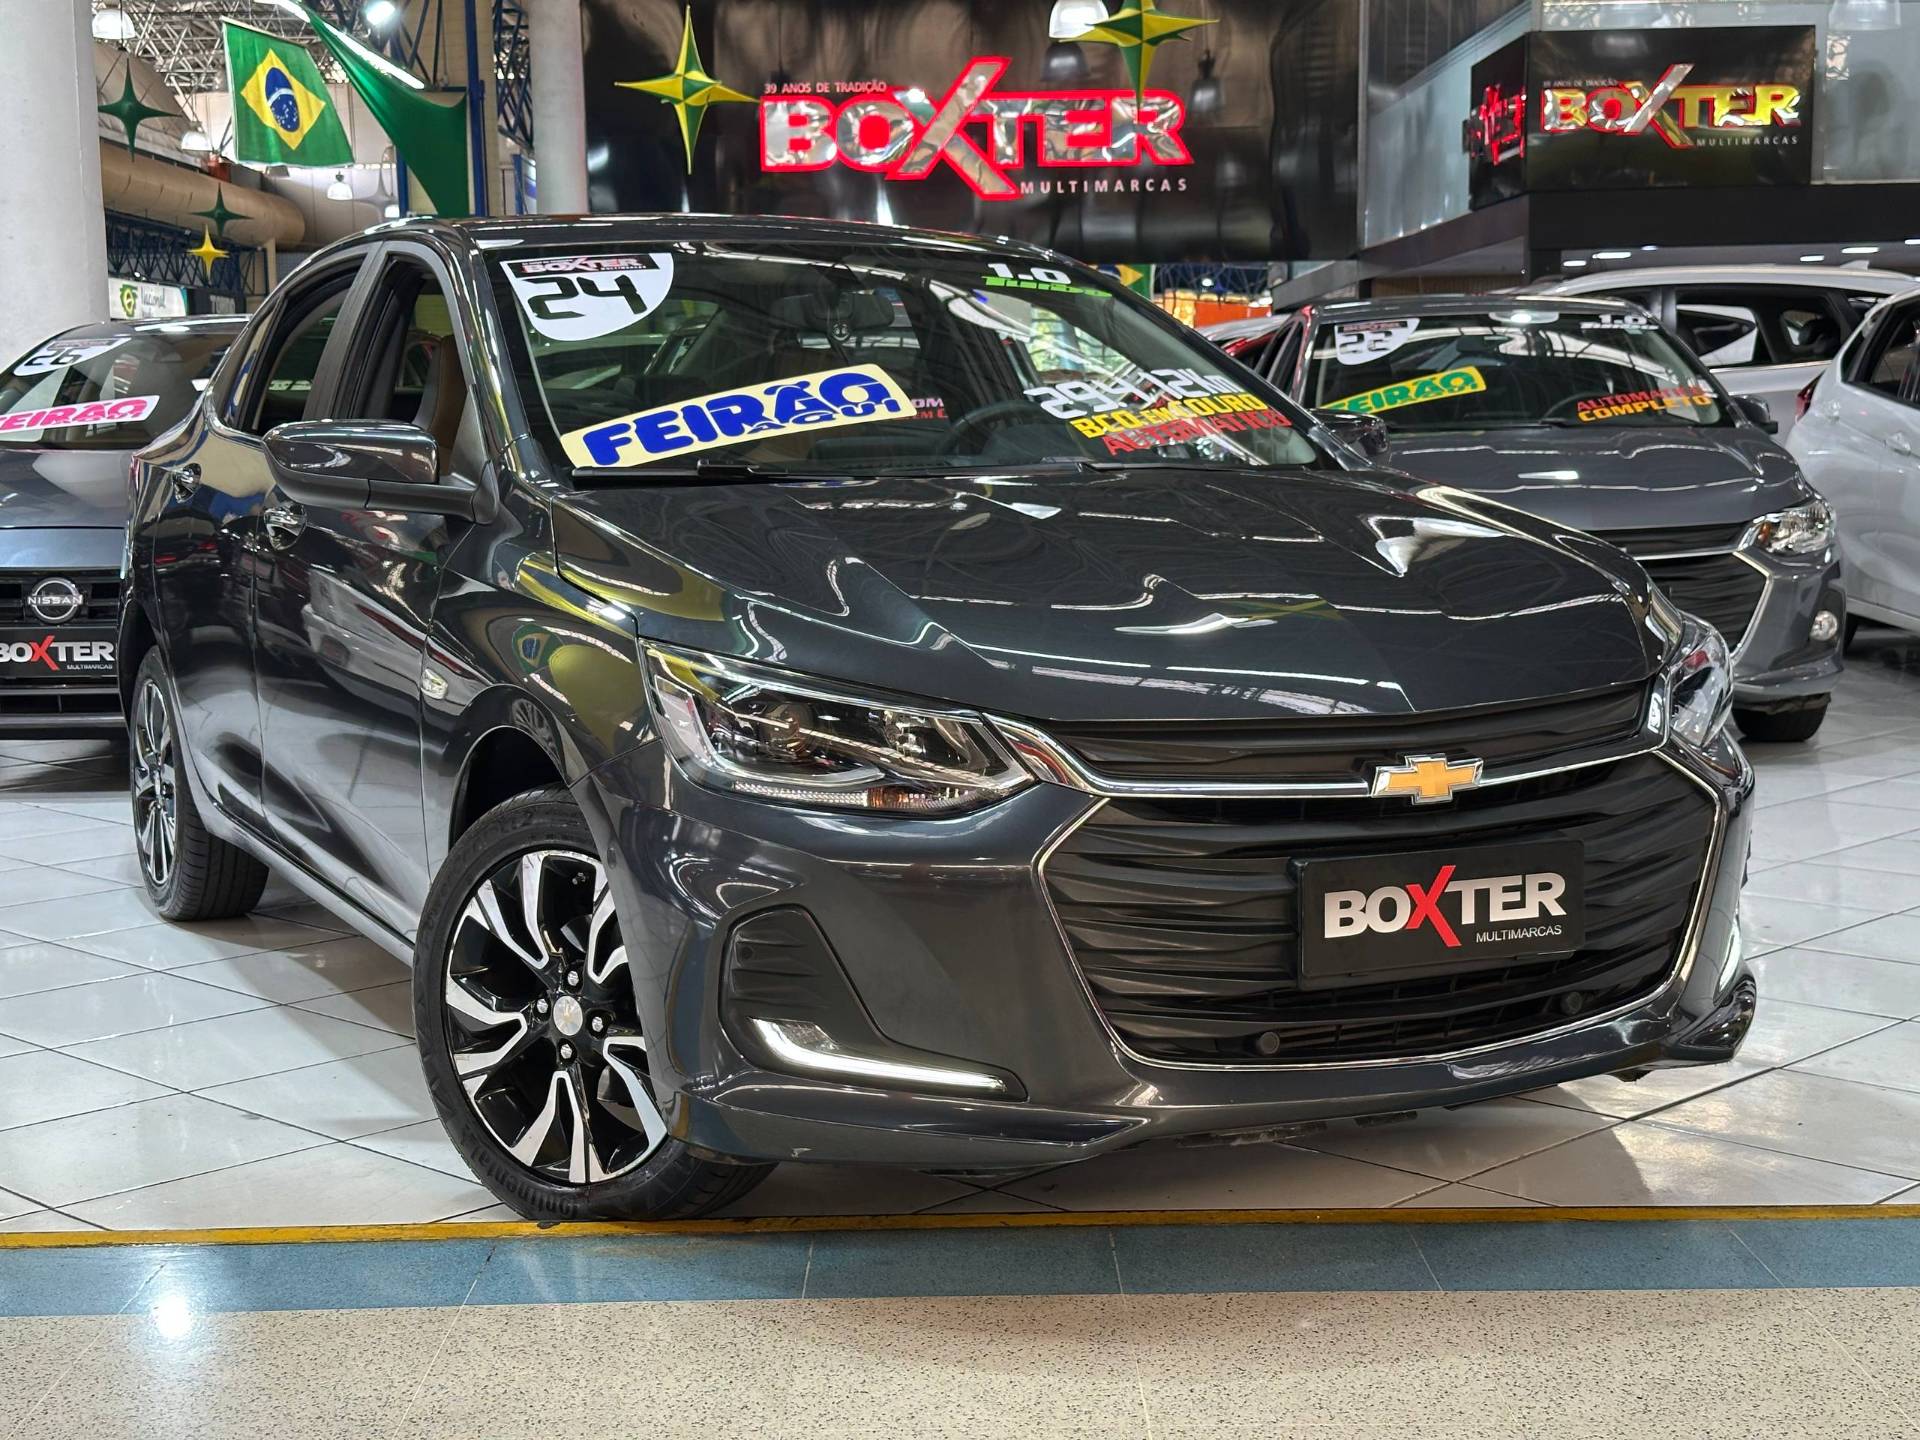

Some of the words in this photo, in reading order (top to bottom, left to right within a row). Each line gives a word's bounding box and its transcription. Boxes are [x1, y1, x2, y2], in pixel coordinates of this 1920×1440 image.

[764, 83, 778, 94] 39
[782, 83, 811, 94] ANOS
[815, 83, 830, 93] DE
[834, 79, 887, 94] TRADIÇÃO
[1541, 63, 1801, 149] BOXTER
[760, 56, 1195, 200] BOXTER
[1696, 135, 1799, 147] MULTIMARCAS
[1021, 178, 1188, 194] MULTIMARCAS
[521, 256, 643, 273] BOXTER
[988, 263, 1071, 284] 1.0
[522, 273, 648, 320] 24
[1167, 393, 1268, 419] COURO
[1578, 395, 1712, 422] COMPLETO
[583, 372, 892, 466] FEIRÃO
[28, 594, 83, 605] NISSAN
[1324, 864, 1567, 947] BOXTER
[1475, 923, 1562, 943] MULTIMARCAS
